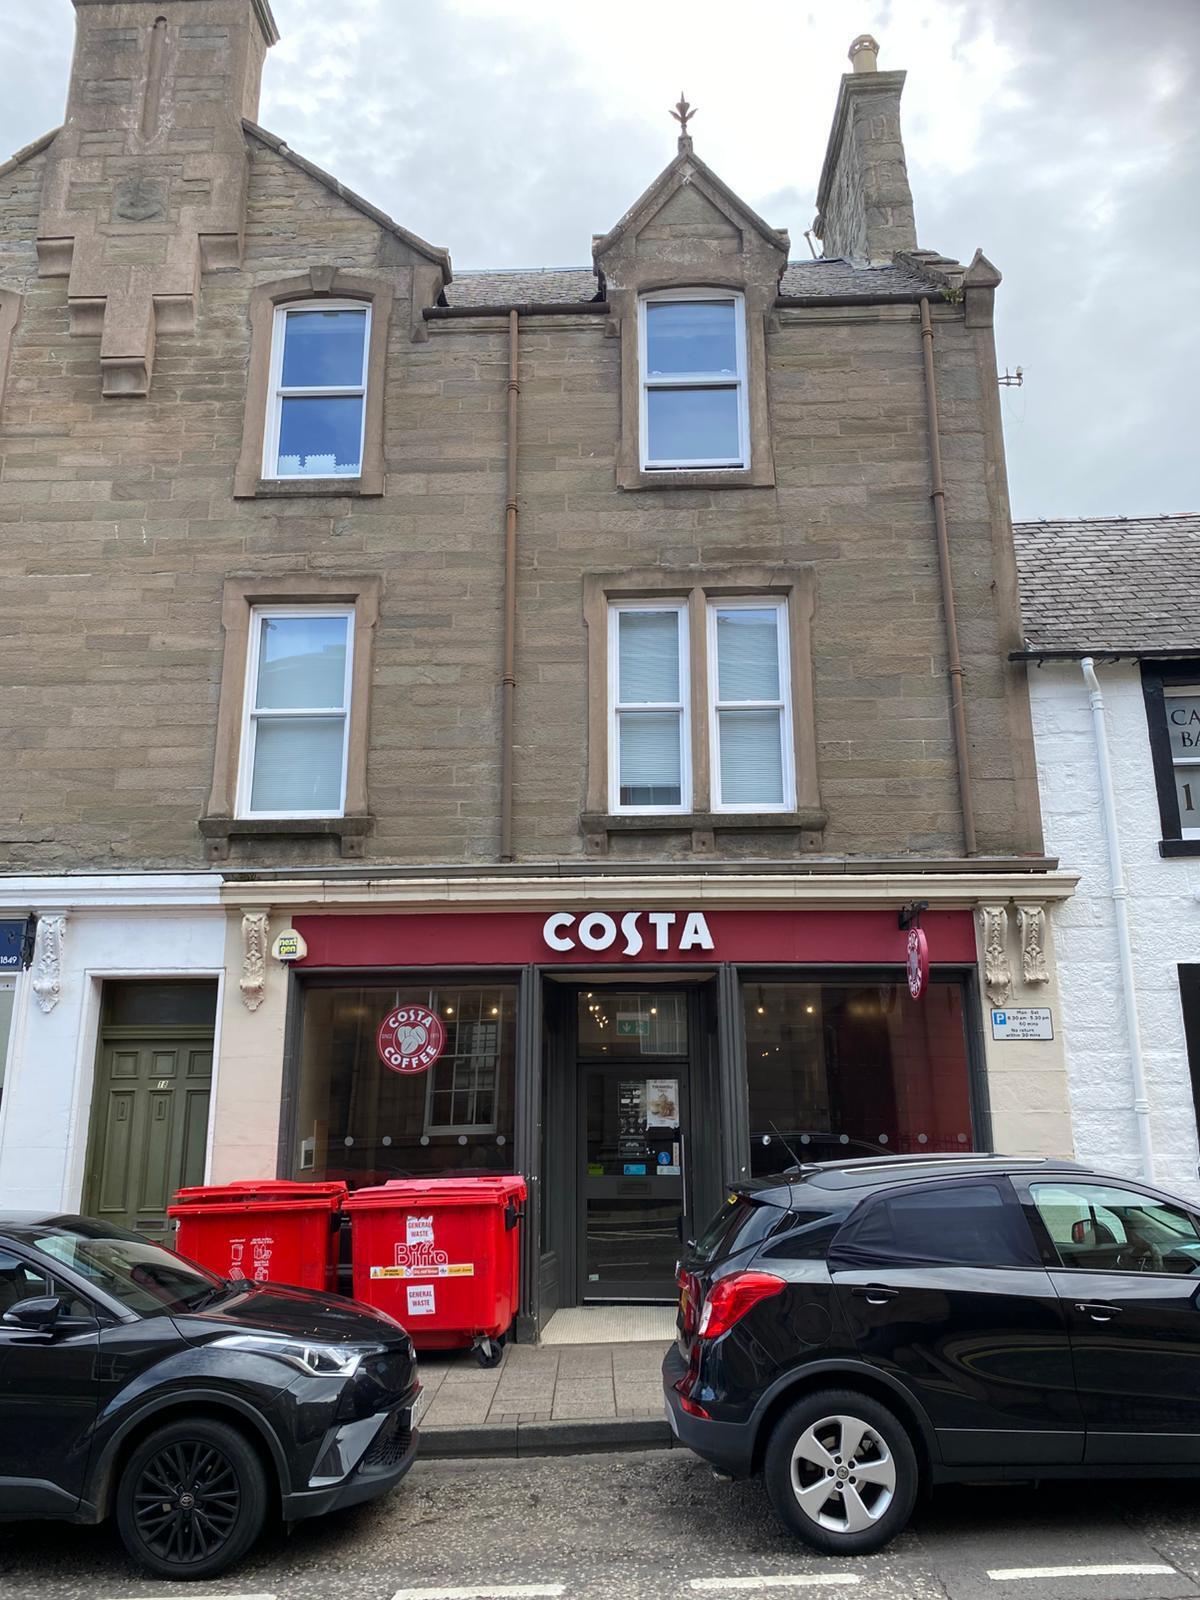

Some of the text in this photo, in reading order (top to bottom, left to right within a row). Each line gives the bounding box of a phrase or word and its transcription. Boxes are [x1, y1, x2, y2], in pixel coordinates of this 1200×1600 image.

[543, 912, 715, 956] COSTA
[281, 946, 295, 954] gen
[0, 956, 17, 964] 1849
[389, 1009, 433, 1027] COSTA
[996, 1014, 1004, 1023] P
[384, 1046, 436, 1068] COFFEE
[408, 1221, 432, 1229] GENERAL
[395, 1242, 448, 1266] Biffa
